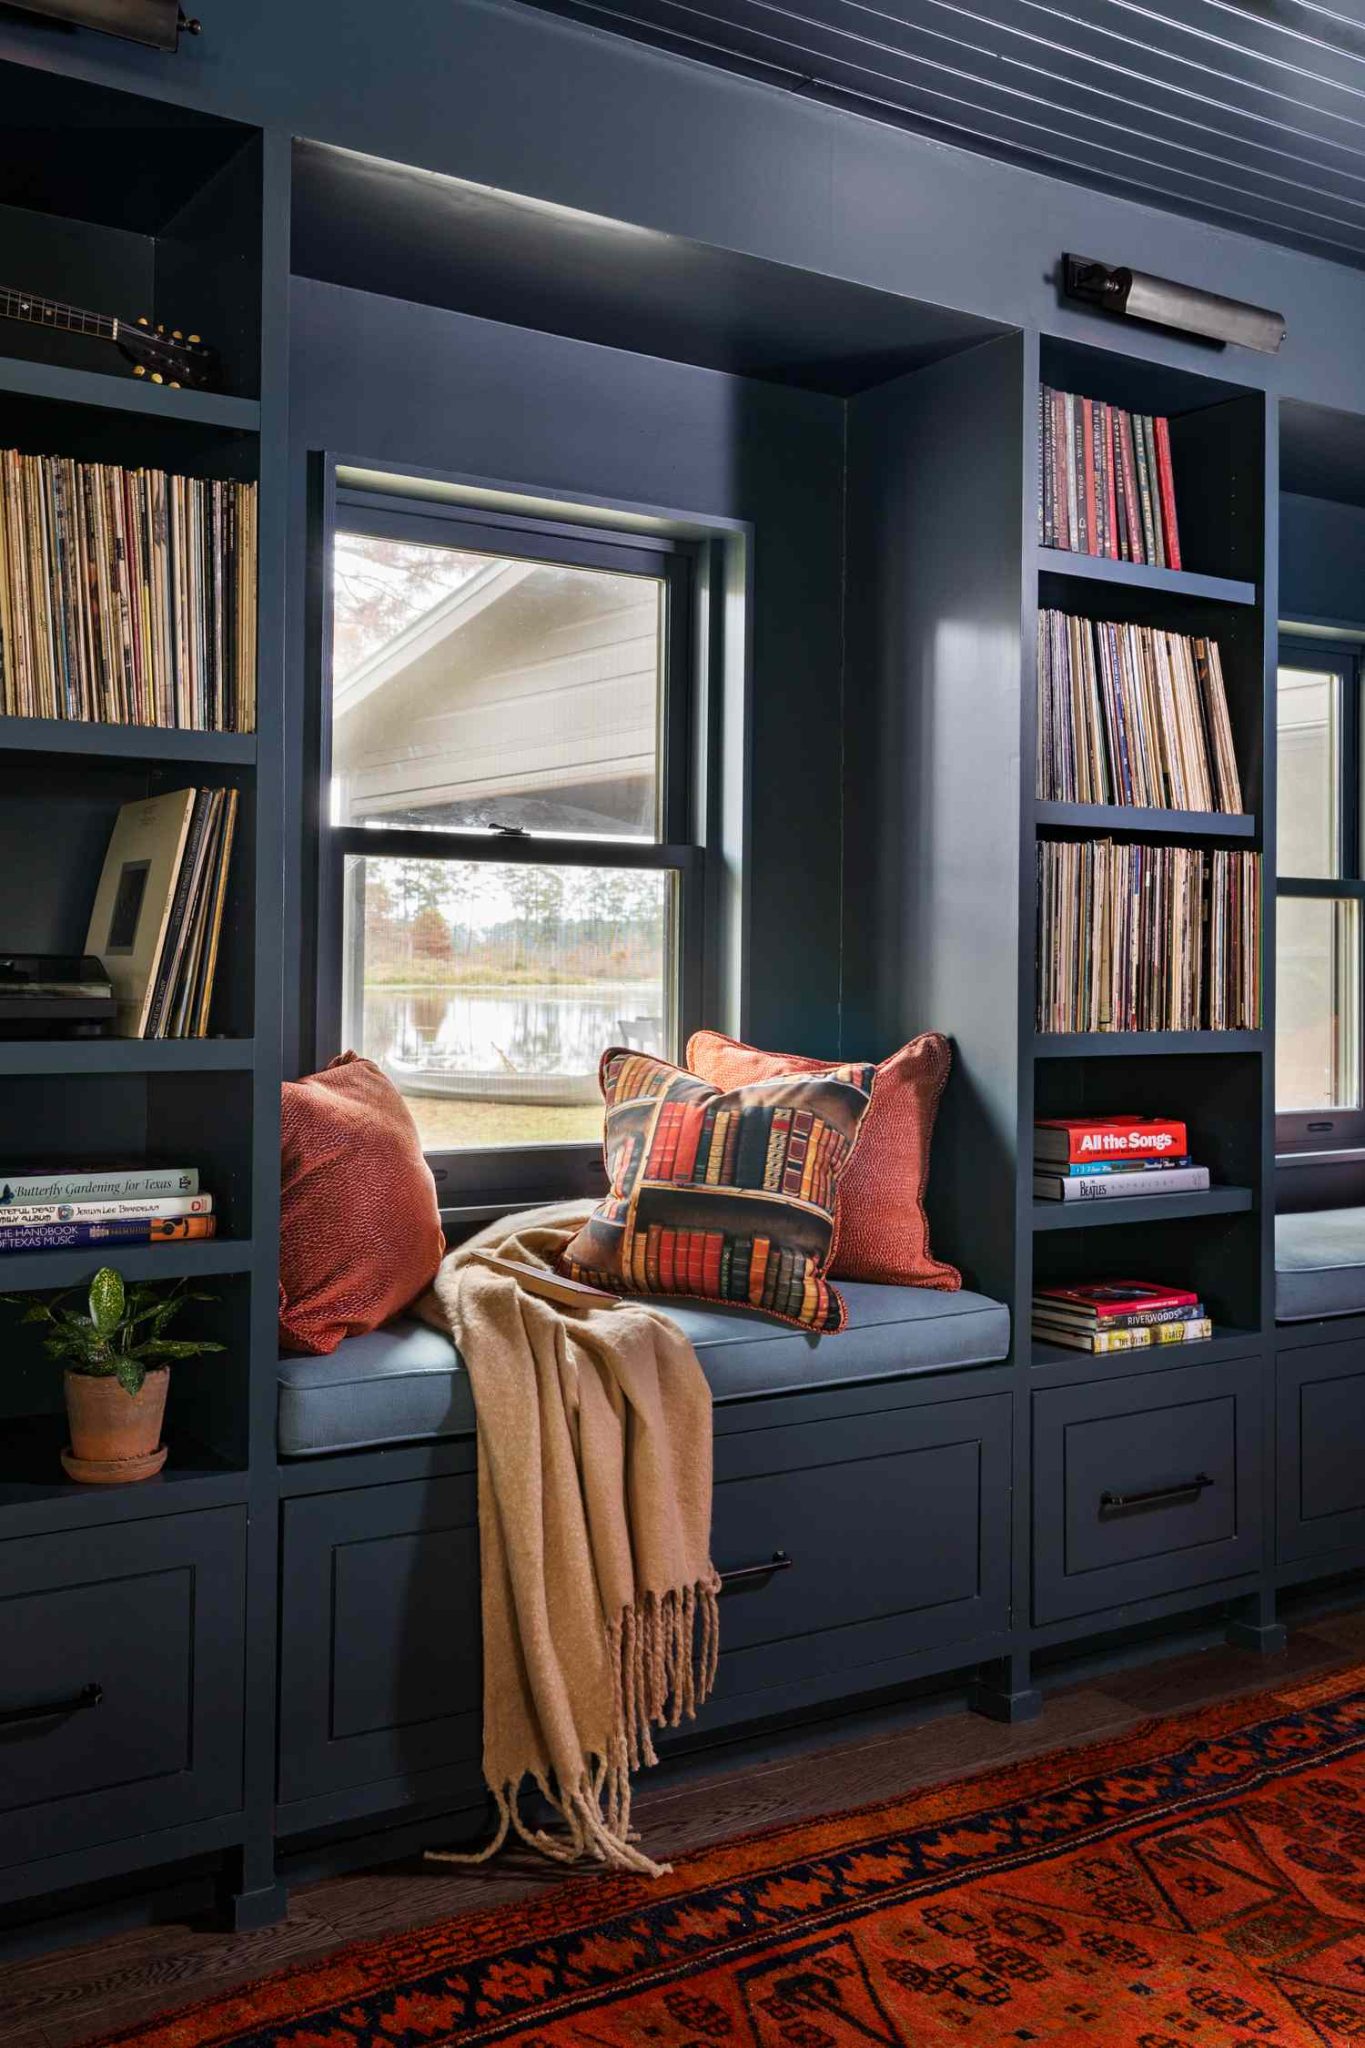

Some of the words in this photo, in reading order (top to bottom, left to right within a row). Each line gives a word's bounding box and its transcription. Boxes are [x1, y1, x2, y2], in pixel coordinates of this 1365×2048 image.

[1080, 1134, 1102, 1151] All
[1103, 1134, 1128, 1149] the
[1128, 1132, 1173, 1151] Songs
[15, 1180, 63, 1198] Butterfly
[65, 1180, 121, 1197] Gardening
[124, 1178, 140, 1194] for
[143, 1178, 173, 1190] Texas
[31, 1206, 56, 1214] DEAD
[15, 1225, 79, 1237] HANDBOOK
[8, 1237, 42, 1248] TEXAS
[44, 1235, 76, 1246] MUSIC
